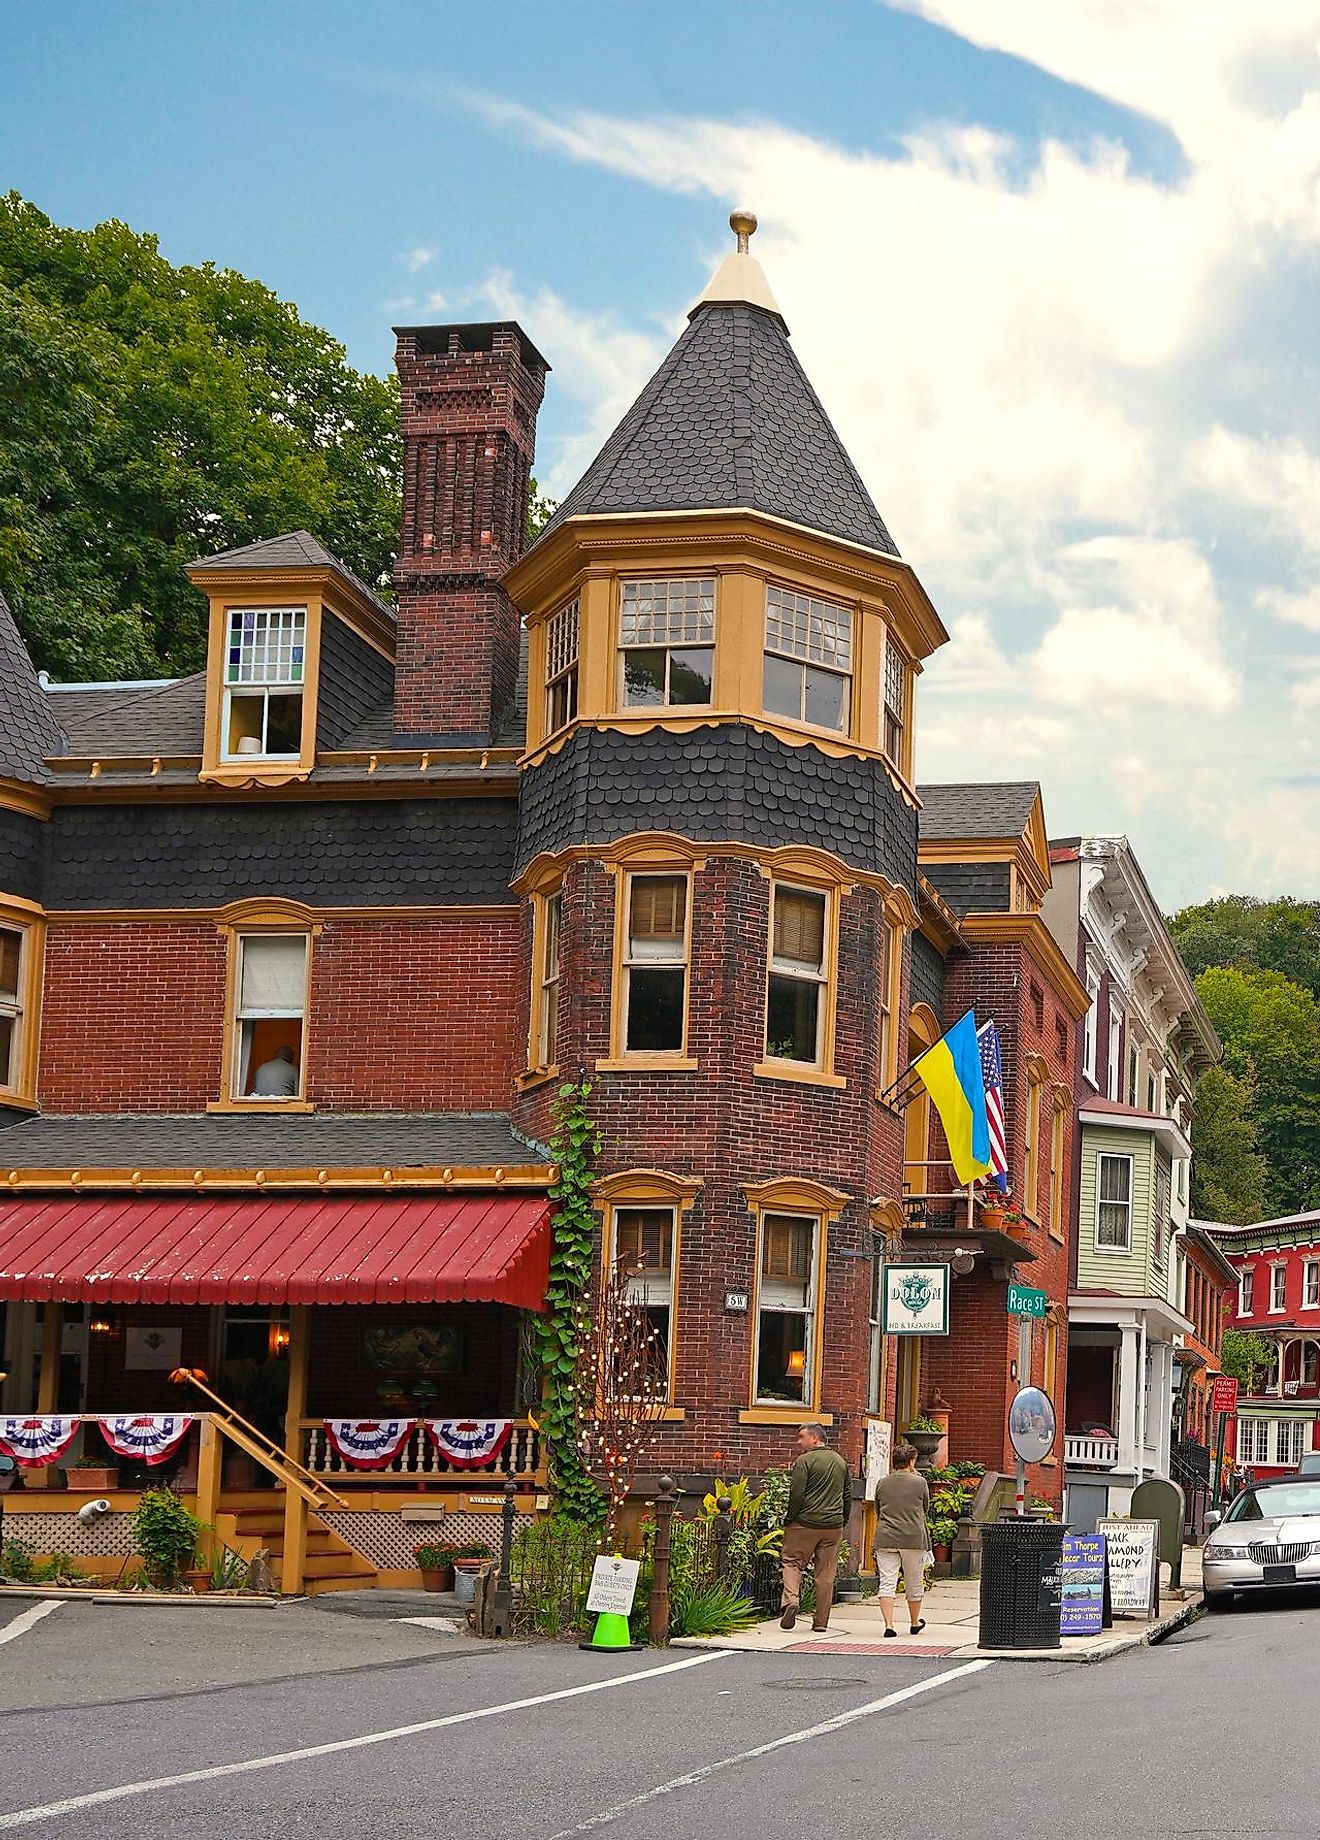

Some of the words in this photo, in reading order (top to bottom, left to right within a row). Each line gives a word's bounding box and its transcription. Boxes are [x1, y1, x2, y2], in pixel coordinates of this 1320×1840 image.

[1010, 1290, 1032, 1311] Race
[1035, 1296, 1043, 1310] ST
[1106, 1533, 1129, 1543] LACK
[1074, 1541, 1098, 1552] Thorpe
[1108, 1545, 1144, 1555] AMOND
[1111, 1558, 1141, 1569] LLERY
